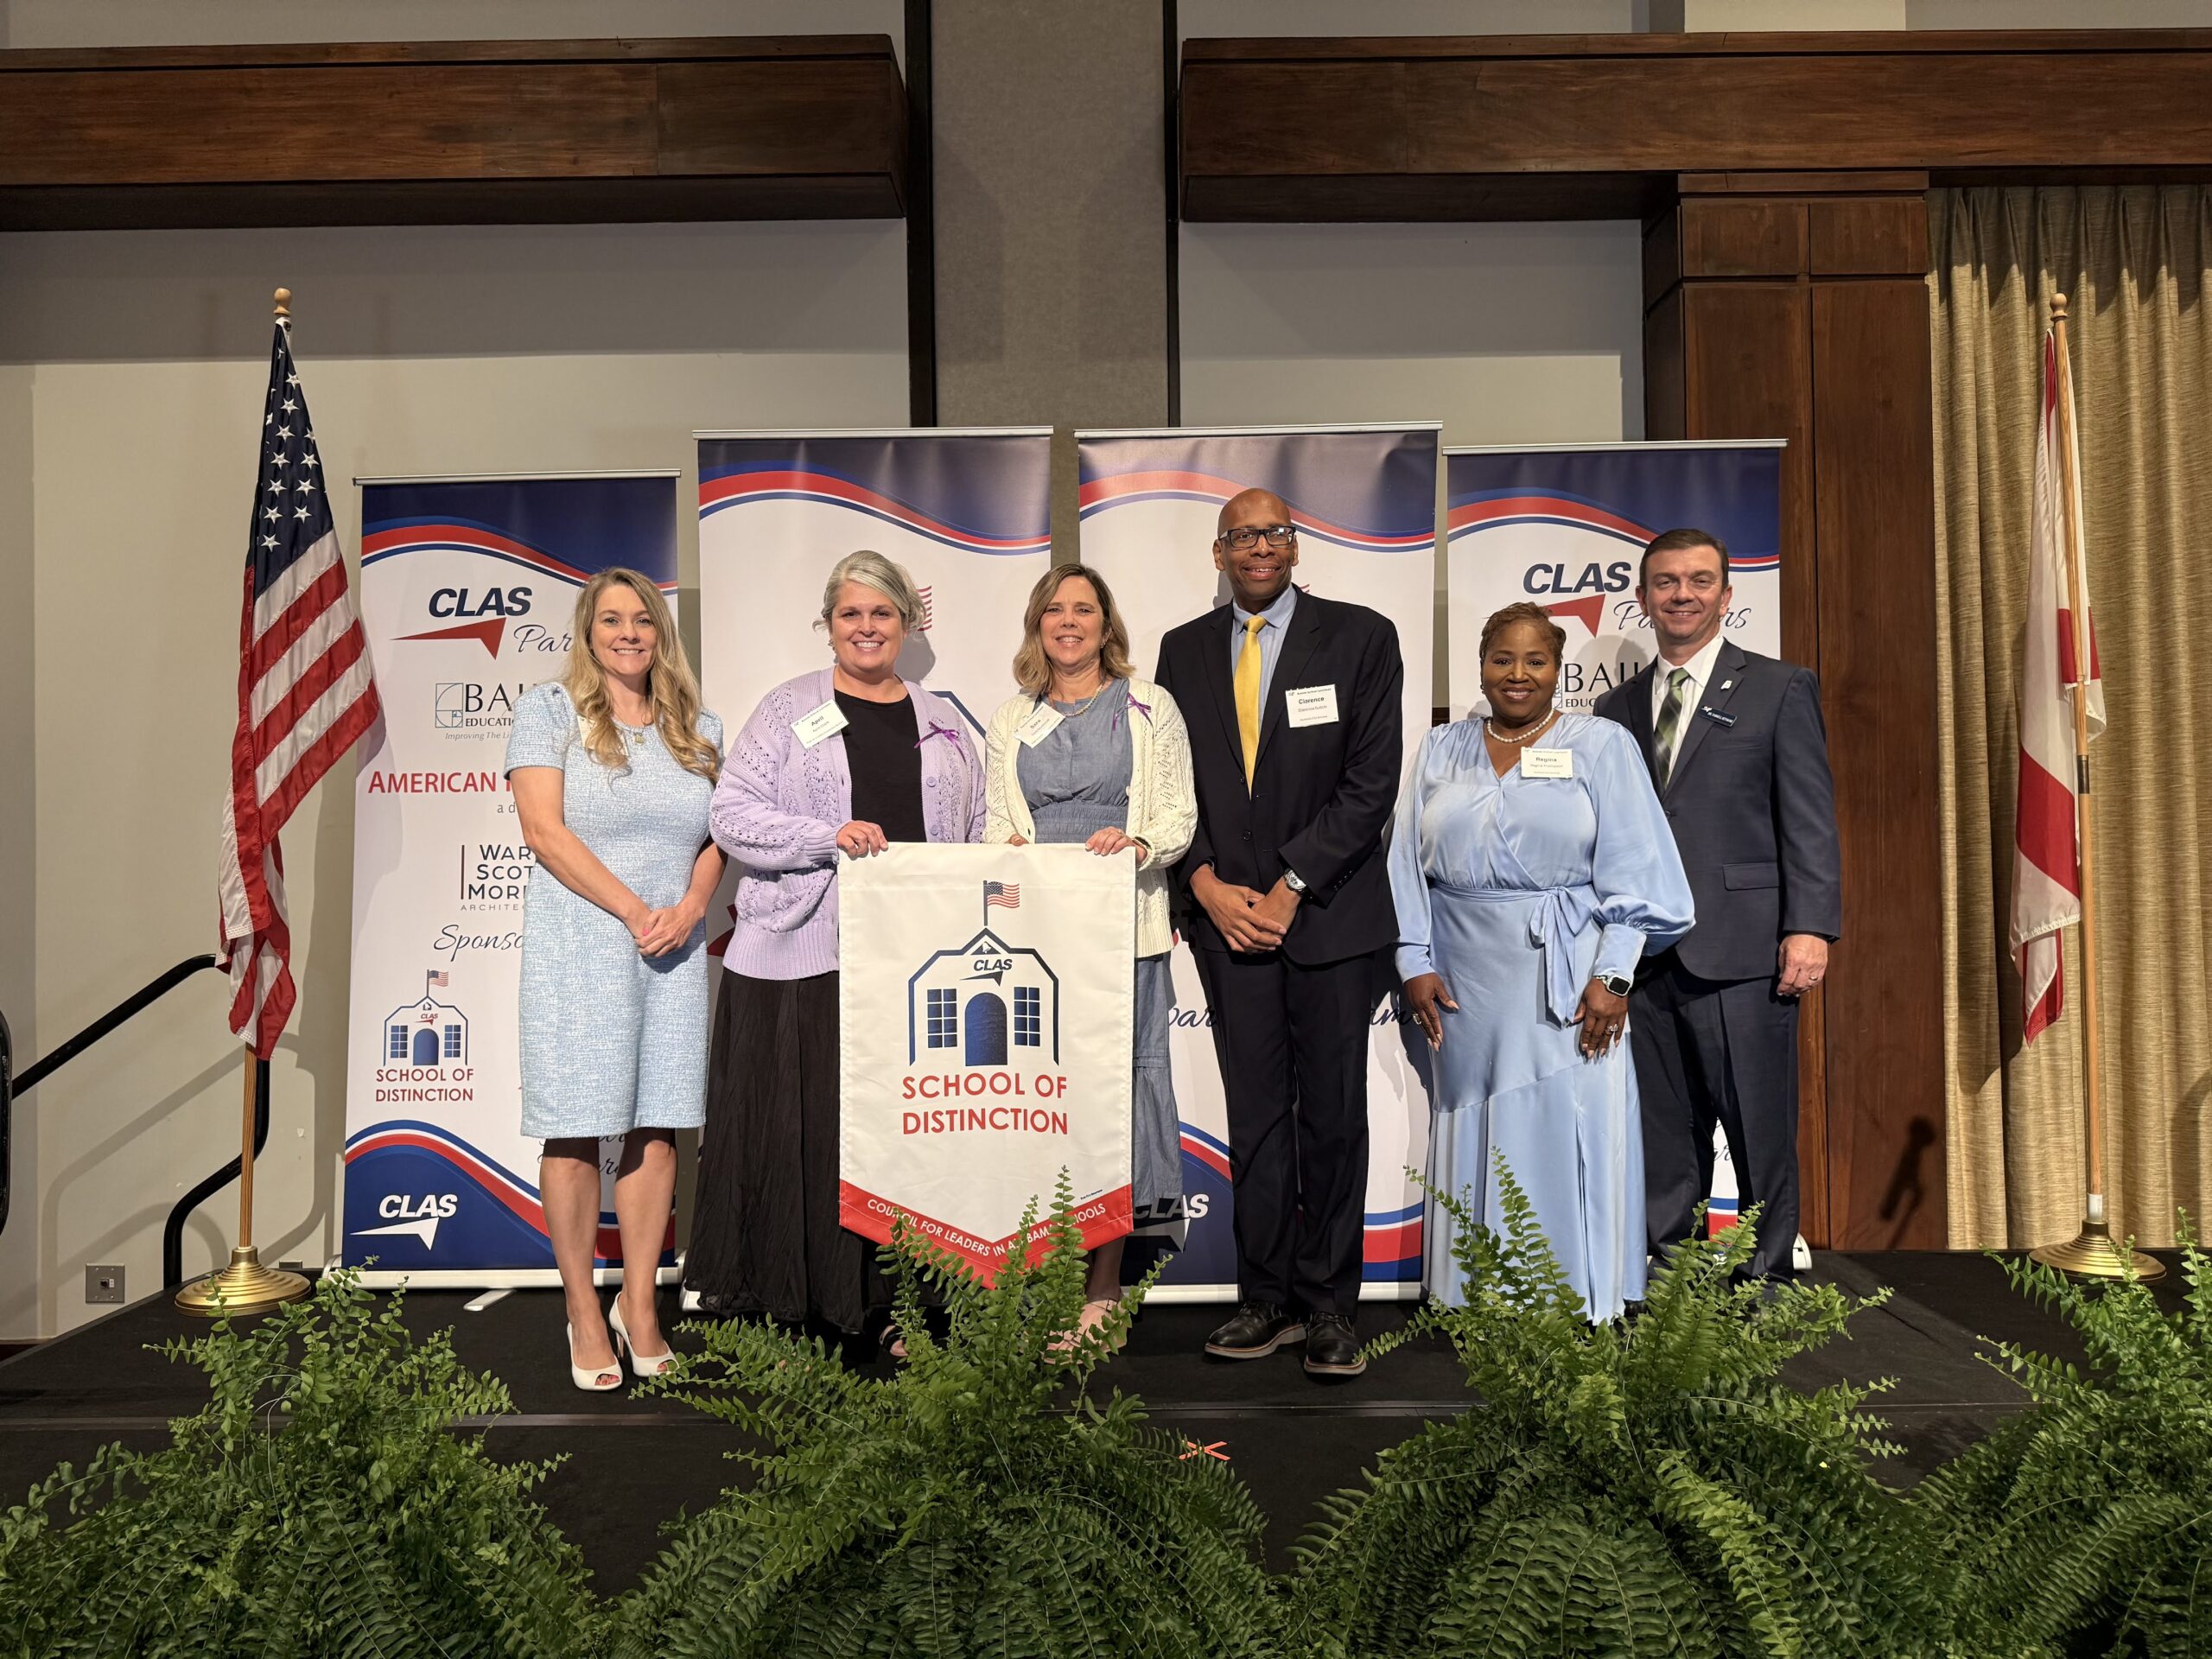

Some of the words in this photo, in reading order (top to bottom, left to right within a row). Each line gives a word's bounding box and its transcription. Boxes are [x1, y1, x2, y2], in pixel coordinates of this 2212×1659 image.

[1522, 562, 1631, 594] CLAS
[429, 587, 532, 617] CLAS
[465, 717, 514, 727] EDUCATI
[811, 715, 824, 726] April
[445, 733, 485, 741] Improving
[368, 771, 497, 793] AMERICAN
[468, 884, 527, 899] MOR
[973, 958, 1013, 971] CLAS
[376, 1068, 446, 1082] SCHOOL
[453, 1068, 474, 1081] OF
[902, 1072, 1025, 1099] SCHOOL
[1035, 1074, 1066, 1098] OF
[376, 1089, 474, 1102] DISTINCTION
[903, 1107, 1068, 1135] DISTINCTION
[379, 1194, 458, 1217] CLAS
[1134, 1193, 1210, 1219] CLAS
[867, 1199, 918, 1227] COUCIL
[920, 1220, 944, 1237] FOR
[944, 1230, 991, 1256] LEADERS
[993, 1243, 1006, 1256] IN
[1007, 1224, 1054, 1249] ABAM
[1057, 1203, 1106, 1227] OOLS
